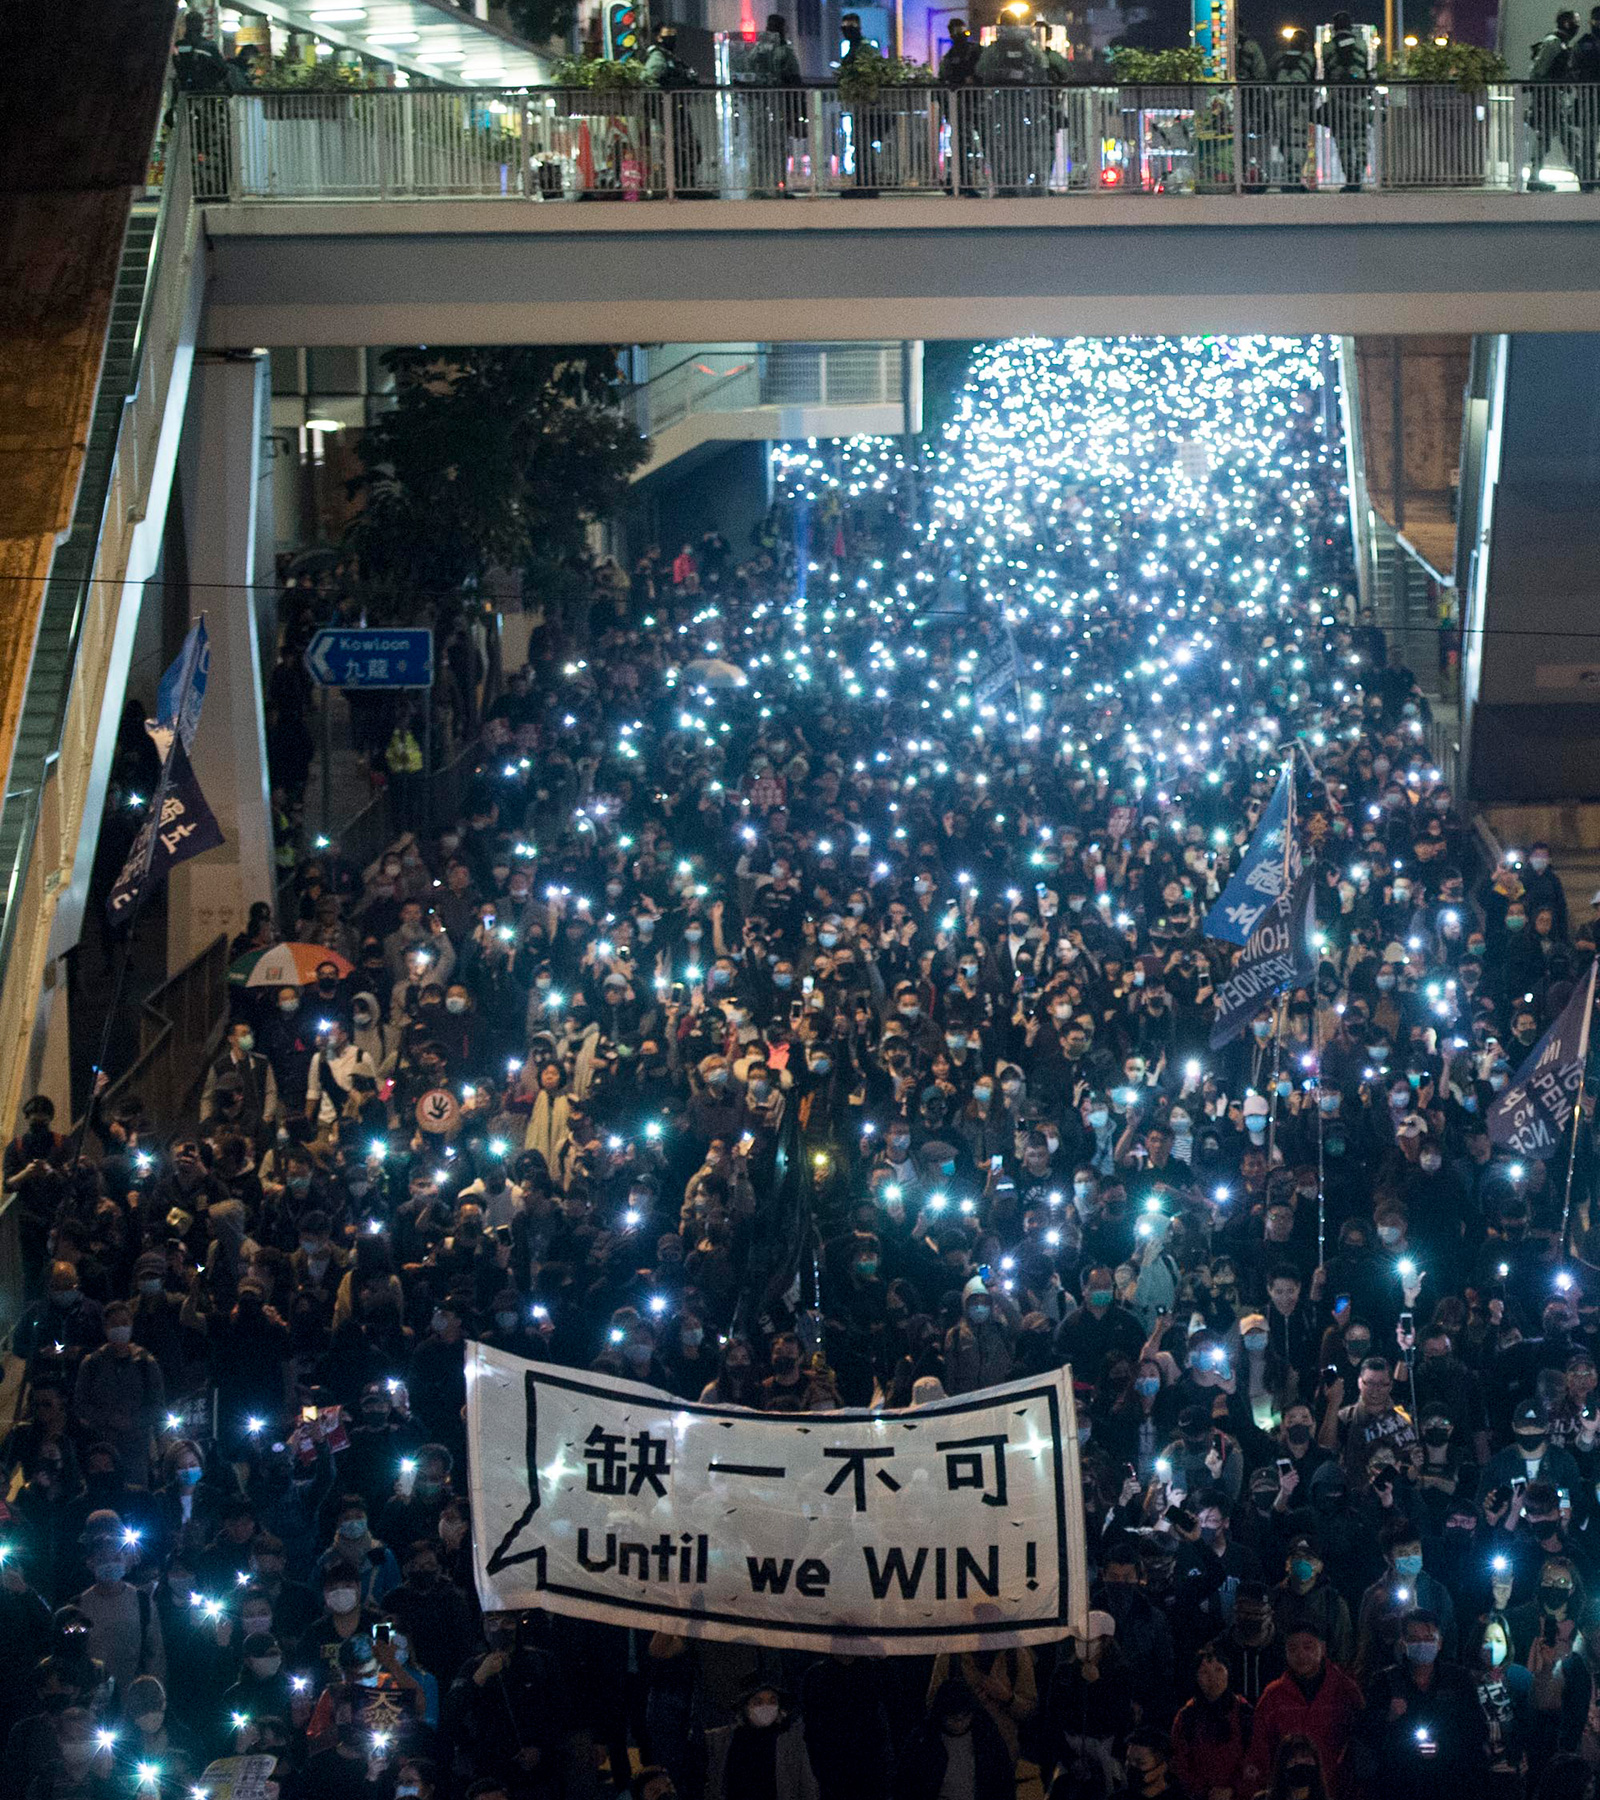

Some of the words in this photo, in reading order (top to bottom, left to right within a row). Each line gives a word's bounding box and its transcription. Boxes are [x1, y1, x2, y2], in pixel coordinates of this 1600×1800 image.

[340, 638, 410, 651] Kowloon
[577, 1528, 708, 1584] Until
[746, 1556, 831, 1598] we
